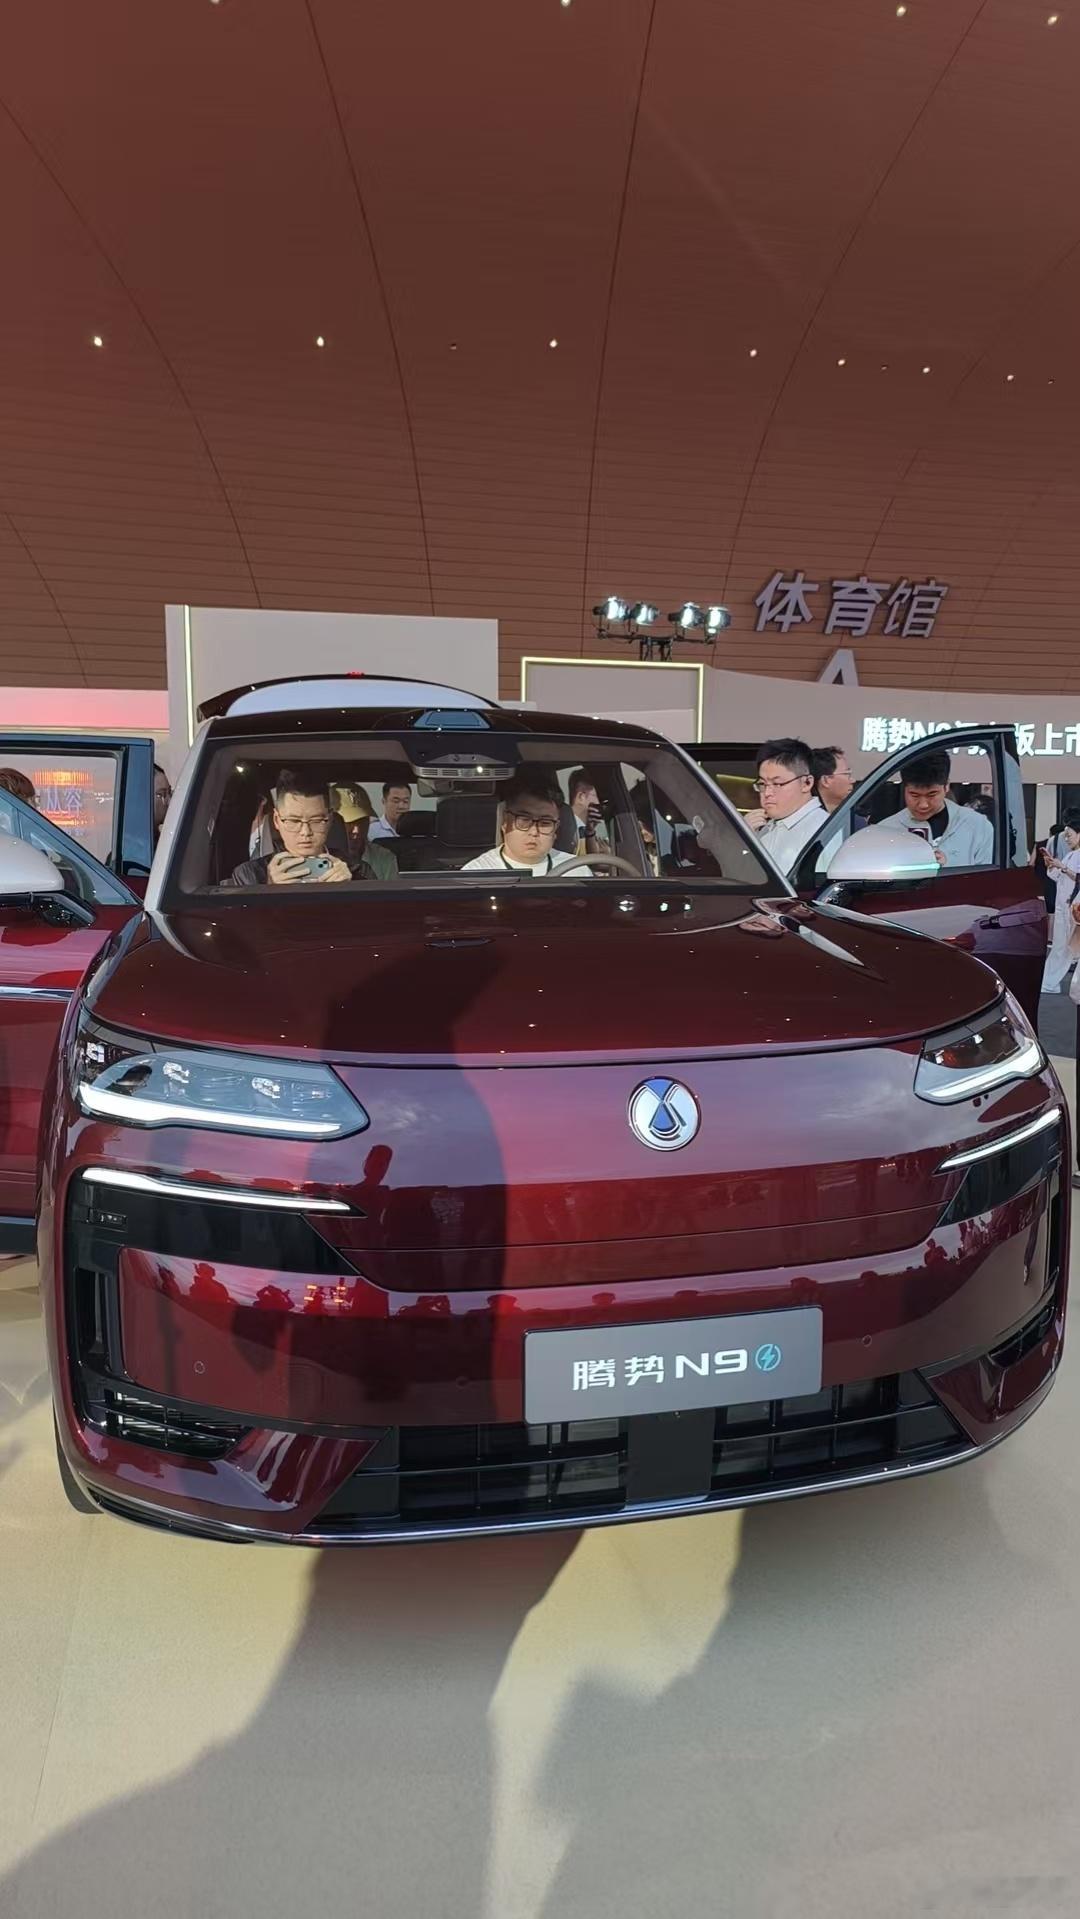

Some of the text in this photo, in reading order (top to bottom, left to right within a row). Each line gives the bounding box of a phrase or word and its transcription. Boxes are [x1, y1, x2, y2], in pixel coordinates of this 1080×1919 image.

[754, 570, 948, 638] 体育馆
[572, 1348, 748, 1391] 腾势N9
